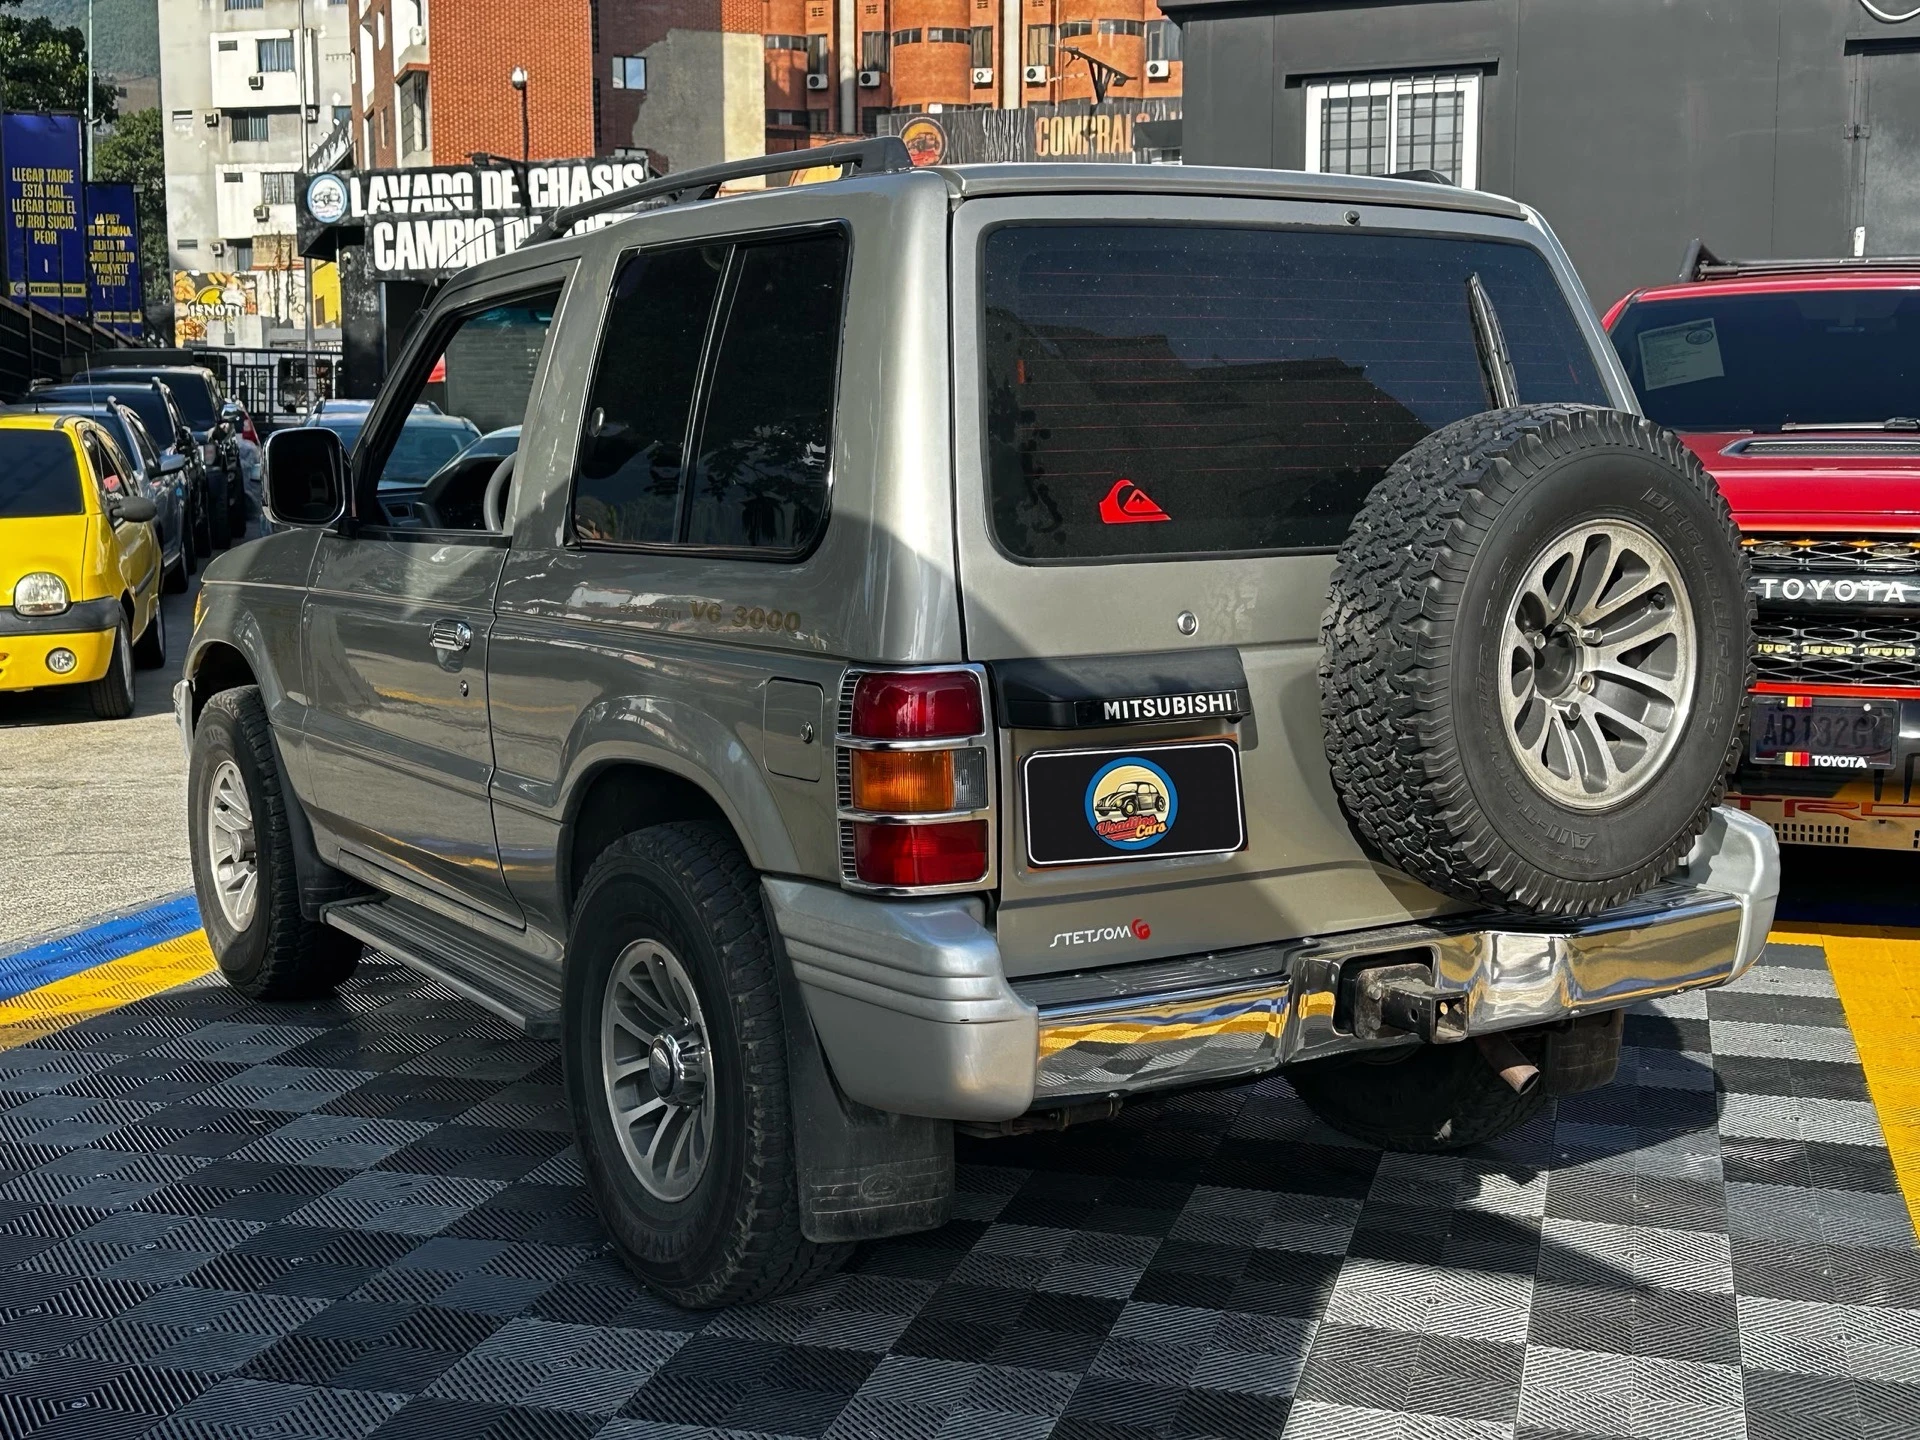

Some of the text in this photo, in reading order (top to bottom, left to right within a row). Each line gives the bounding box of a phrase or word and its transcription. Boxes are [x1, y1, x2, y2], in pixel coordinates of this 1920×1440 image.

[12, 167, 74, 183] LLEGAR TARDE
[350, 162, 645, 218] LAVADO DE CHASIS
[46, 199, 65, 214] CON
[66, 200, 77, 214] EL
[34, 230, 57, 245] PEOR
[373, 217, 498, 272] CAMBIO
[1759, 577, 1907, 604] TOYOTA
[690, 600, 723, 625] V6
[731, 605, 802, 633] 3000
[1103, 692, 1233, 721] MITSUBISHI
[1811, 755, 1868, 769] TOYOTA
[1096, 813, 1158, 837] Usaditos
[1135, 821, 1169, 840] Cars
[1049, 924, 1132, 949] STETSOM
